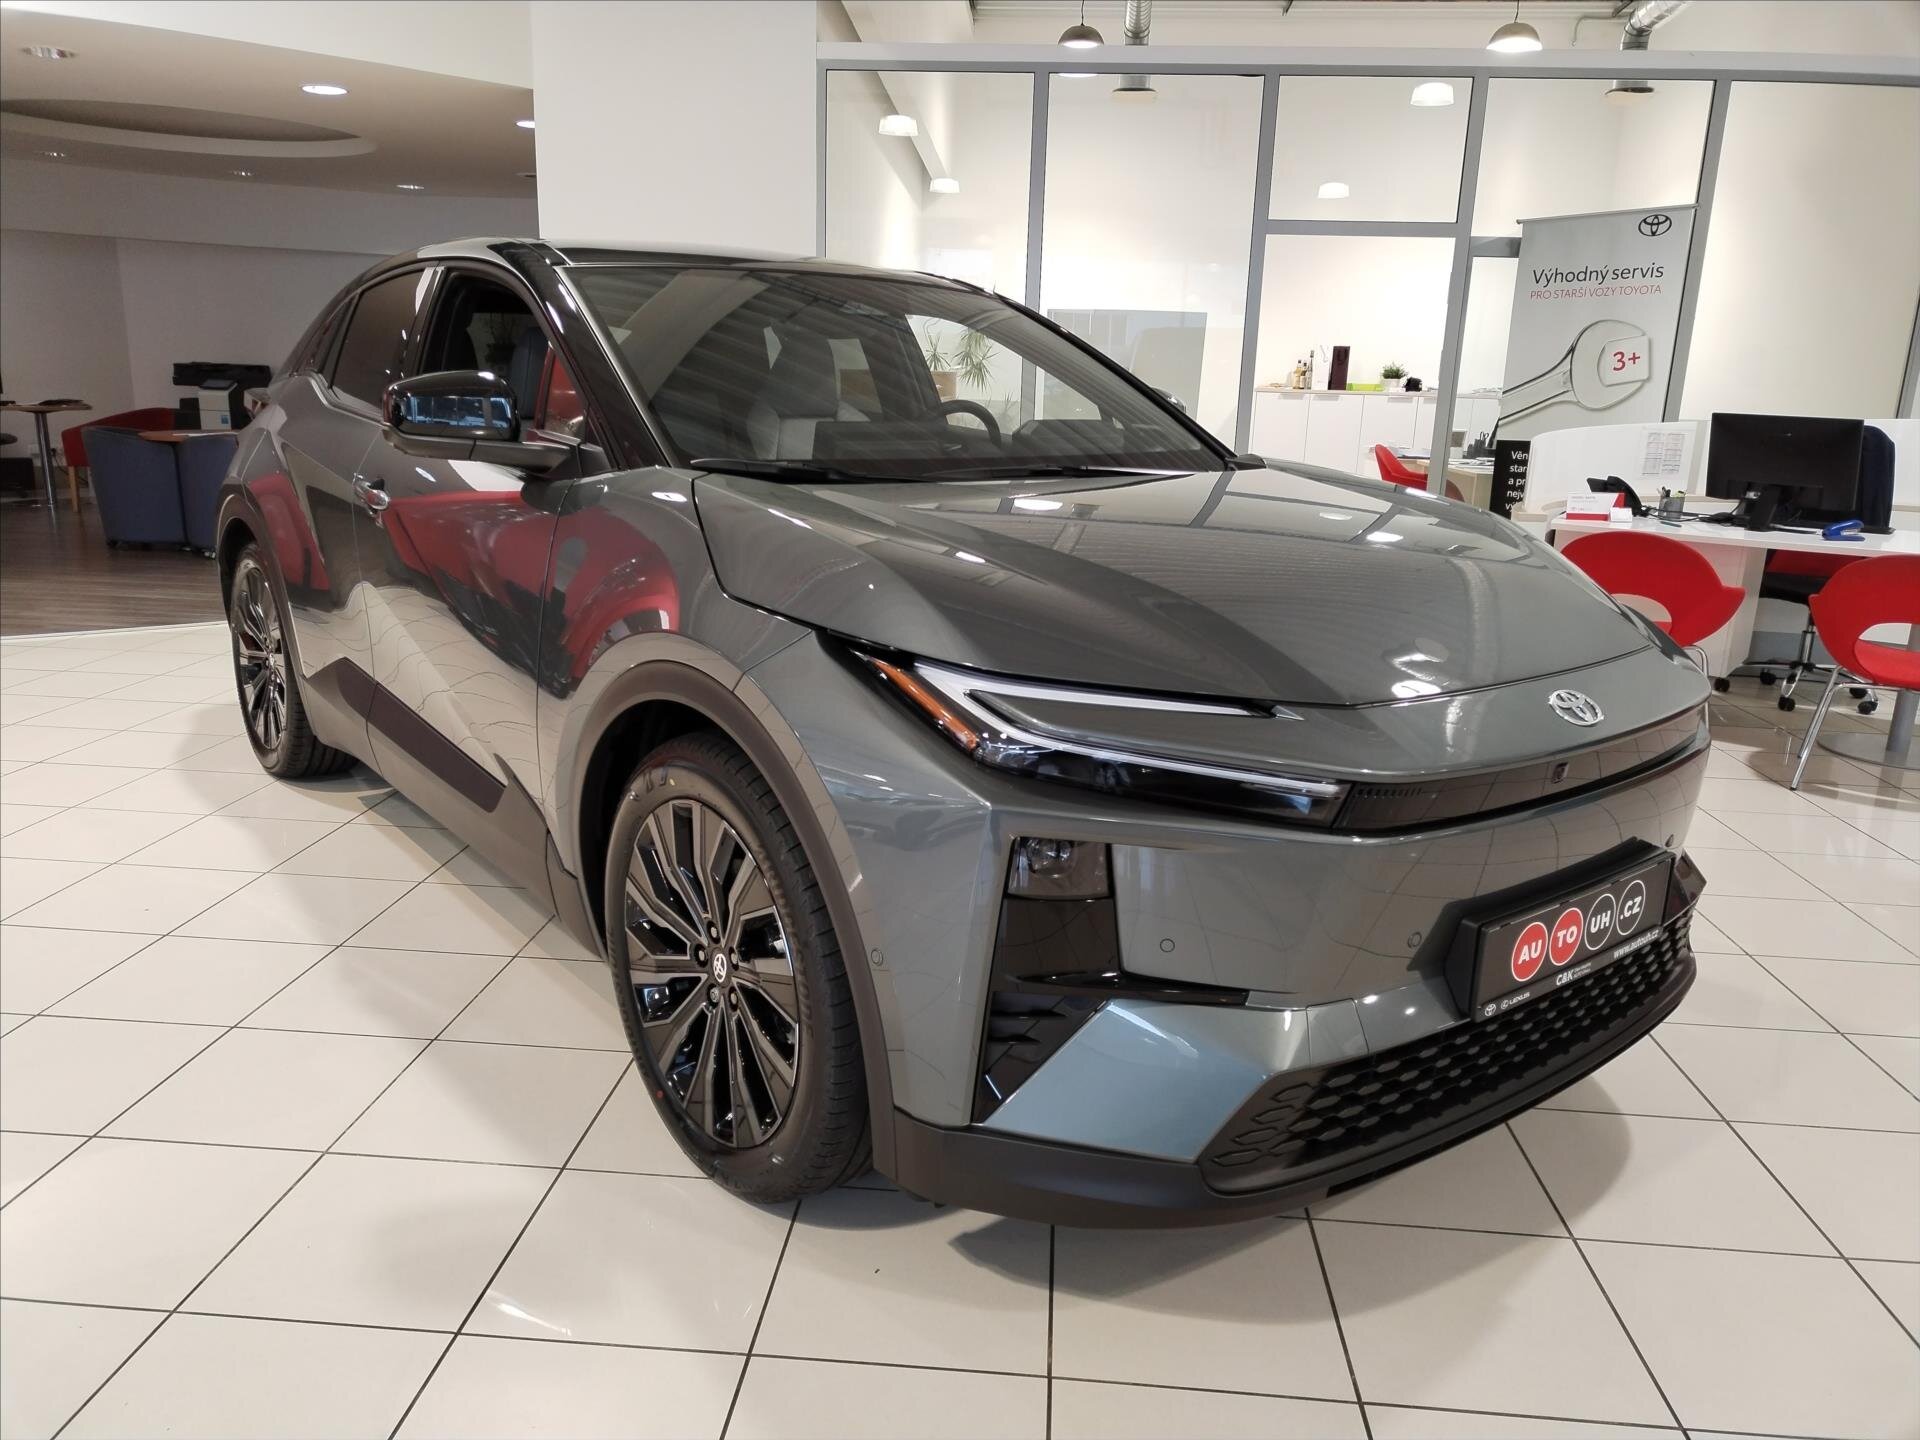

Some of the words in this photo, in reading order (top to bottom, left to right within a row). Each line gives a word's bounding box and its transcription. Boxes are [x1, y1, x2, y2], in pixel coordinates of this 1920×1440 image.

[1533, 265, 1609, 288] Výhodný
[1611, 262, 1664, 280] servis
[1530, 290, 1552, 300] PRO
[1553, 286, 1588, 299] STARŠÍ
[1588, 287, 1617, 297] VOZY
[1619, 284, 1662, 296] TOYOTA
[1613, 351, 1640, 371] 3+
[1511, 450, 1529, 460] Věn
[1509, 464, 1528, 473] star
[1516, 478, 1526, 487] pr
[1506, 490, 1524, 500] nejv
[1518, 939, 1543, 965] AU
[1557, 925, 1578, 948] TO
[1590, 910, 1611, 933] UH
[1620, 895, 1642, 920] .CZ
